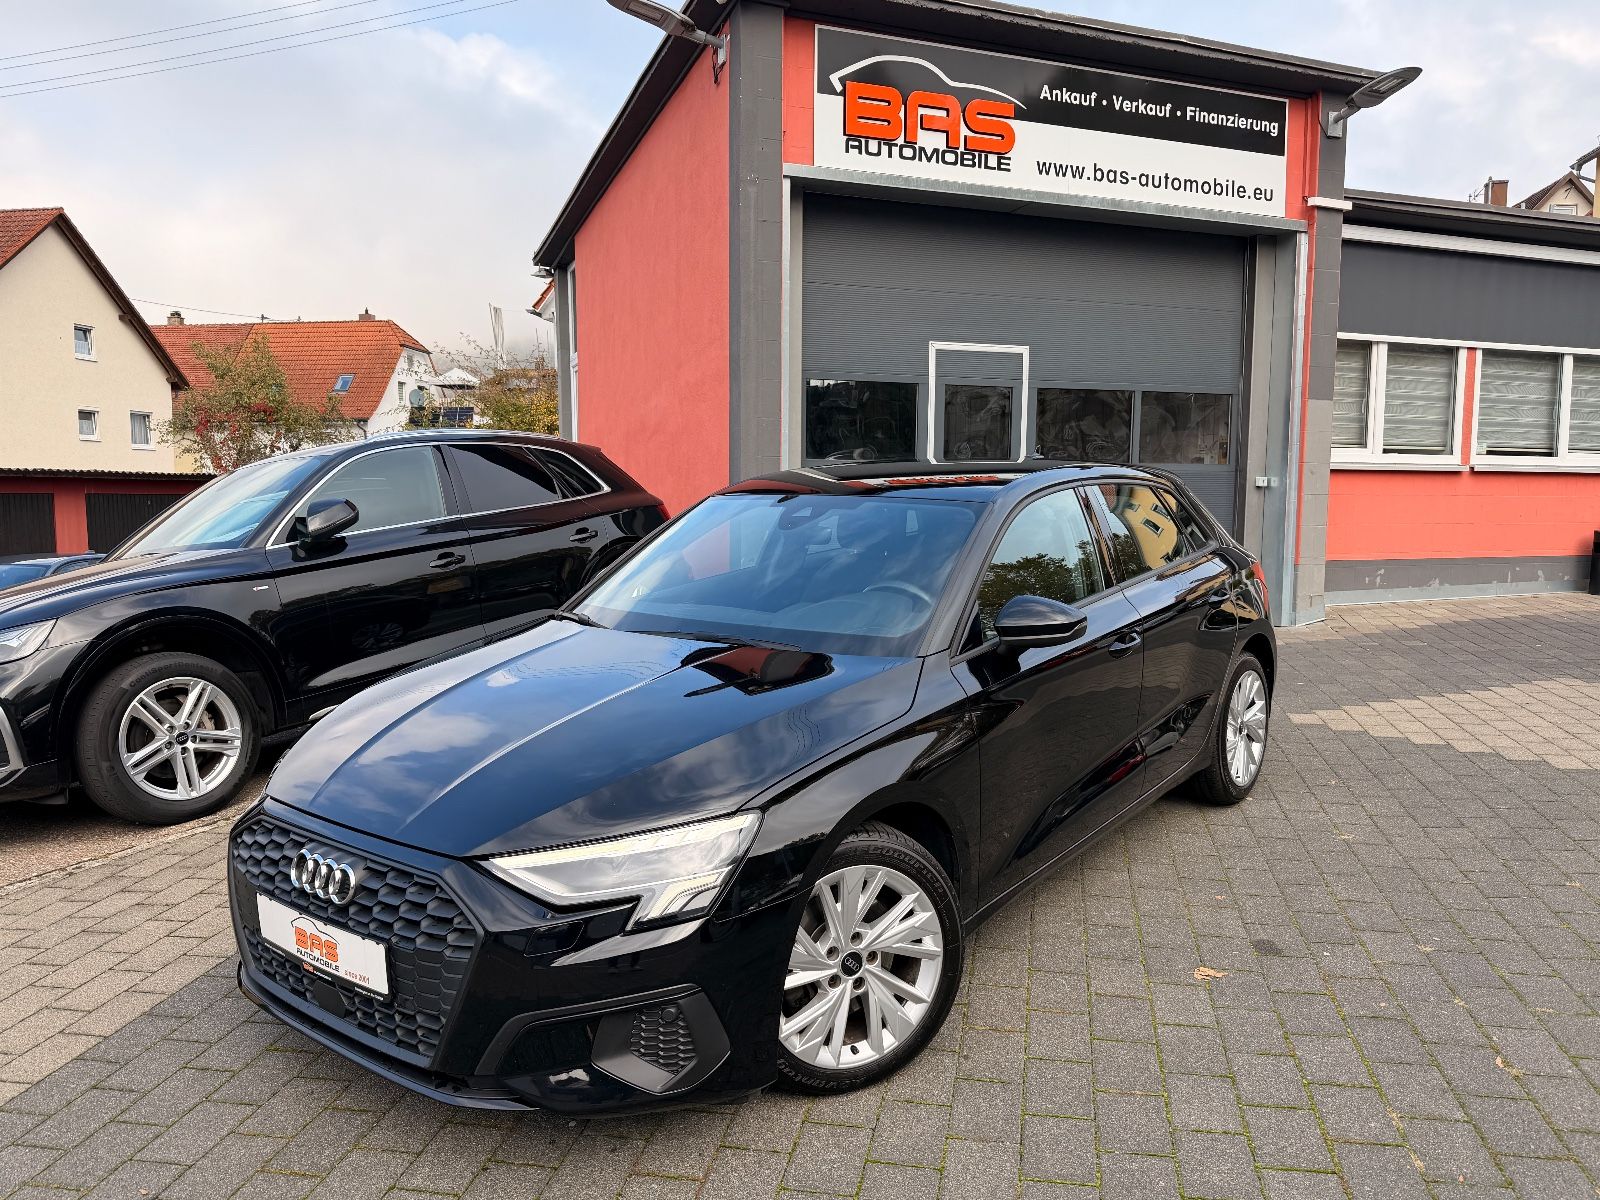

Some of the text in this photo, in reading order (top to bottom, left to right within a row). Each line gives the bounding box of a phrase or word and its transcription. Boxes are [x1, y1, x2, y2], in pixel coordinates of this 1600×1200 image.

[844, 80, 1016, 155] BAS
[1039, 84, 1280, 136] Ankauf Verkauf Finanzierung
[844, 137, 1012, 172] AUTOMOBILE
[1036, 158, 1275, 202] www.bas-automobile.eu
[295, 925, 339, 963] BAS
[296, 947, 340, 973] AUTOMOBILE
